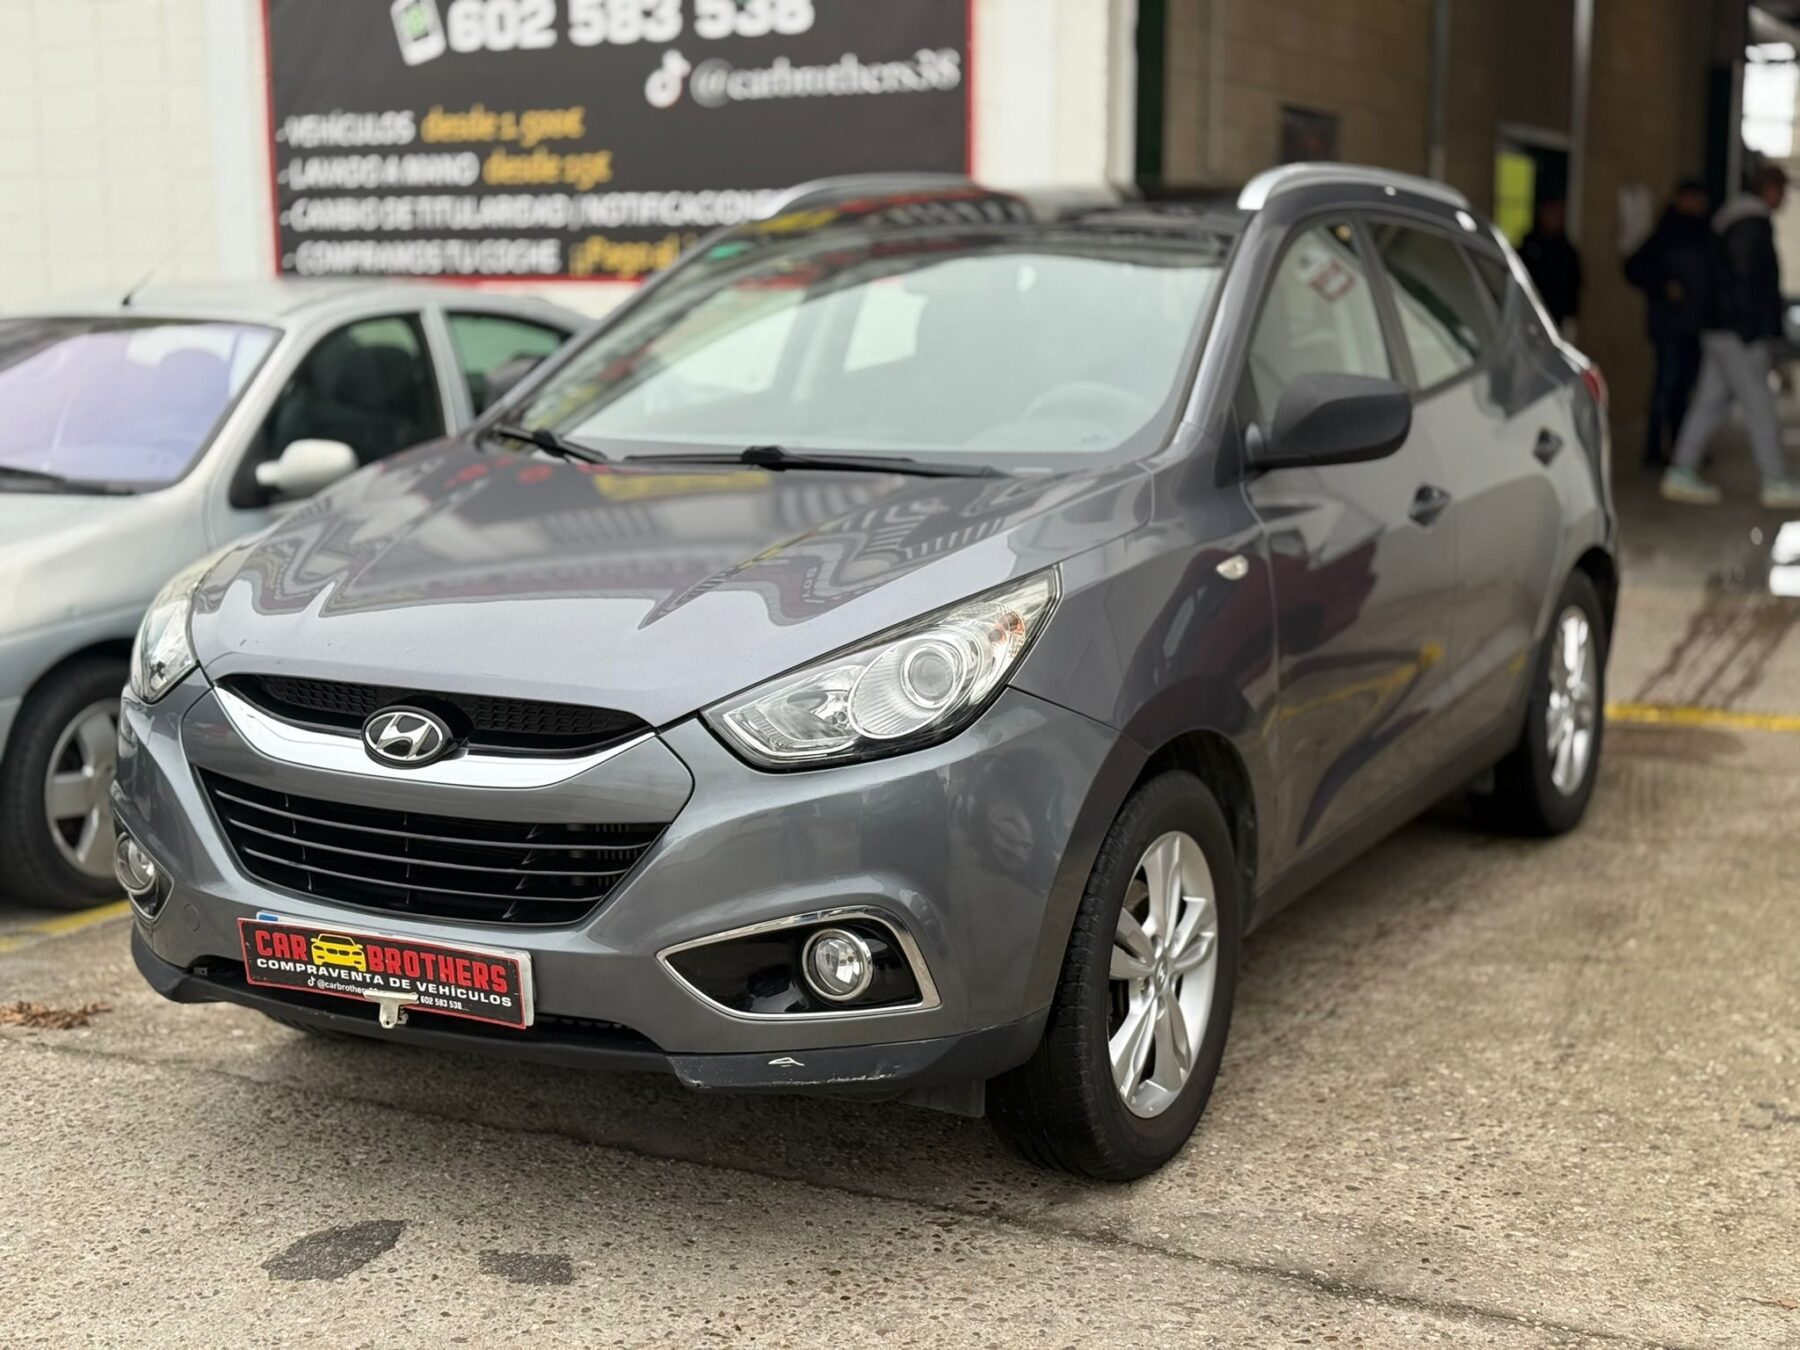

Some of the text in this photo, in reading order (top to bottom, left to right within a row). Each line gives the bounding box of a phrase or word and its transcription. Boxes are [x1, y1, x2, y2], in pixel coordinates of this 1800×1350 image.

[448, 0, 816, 52] 602 583 538
[691, 48, 961, 107] @carbrothers38
[421, 103, 498, 144] desde
[483, 147, 560, 185] desde
[478, 237, 561, 275] COCHE
[255, 930, 508, 993] CAR BROTHERS
[257, 958, 512, 1008] COMPRAVENTA DE VEHÍCULOS
[317, 978, 379, 995] @carbrother
